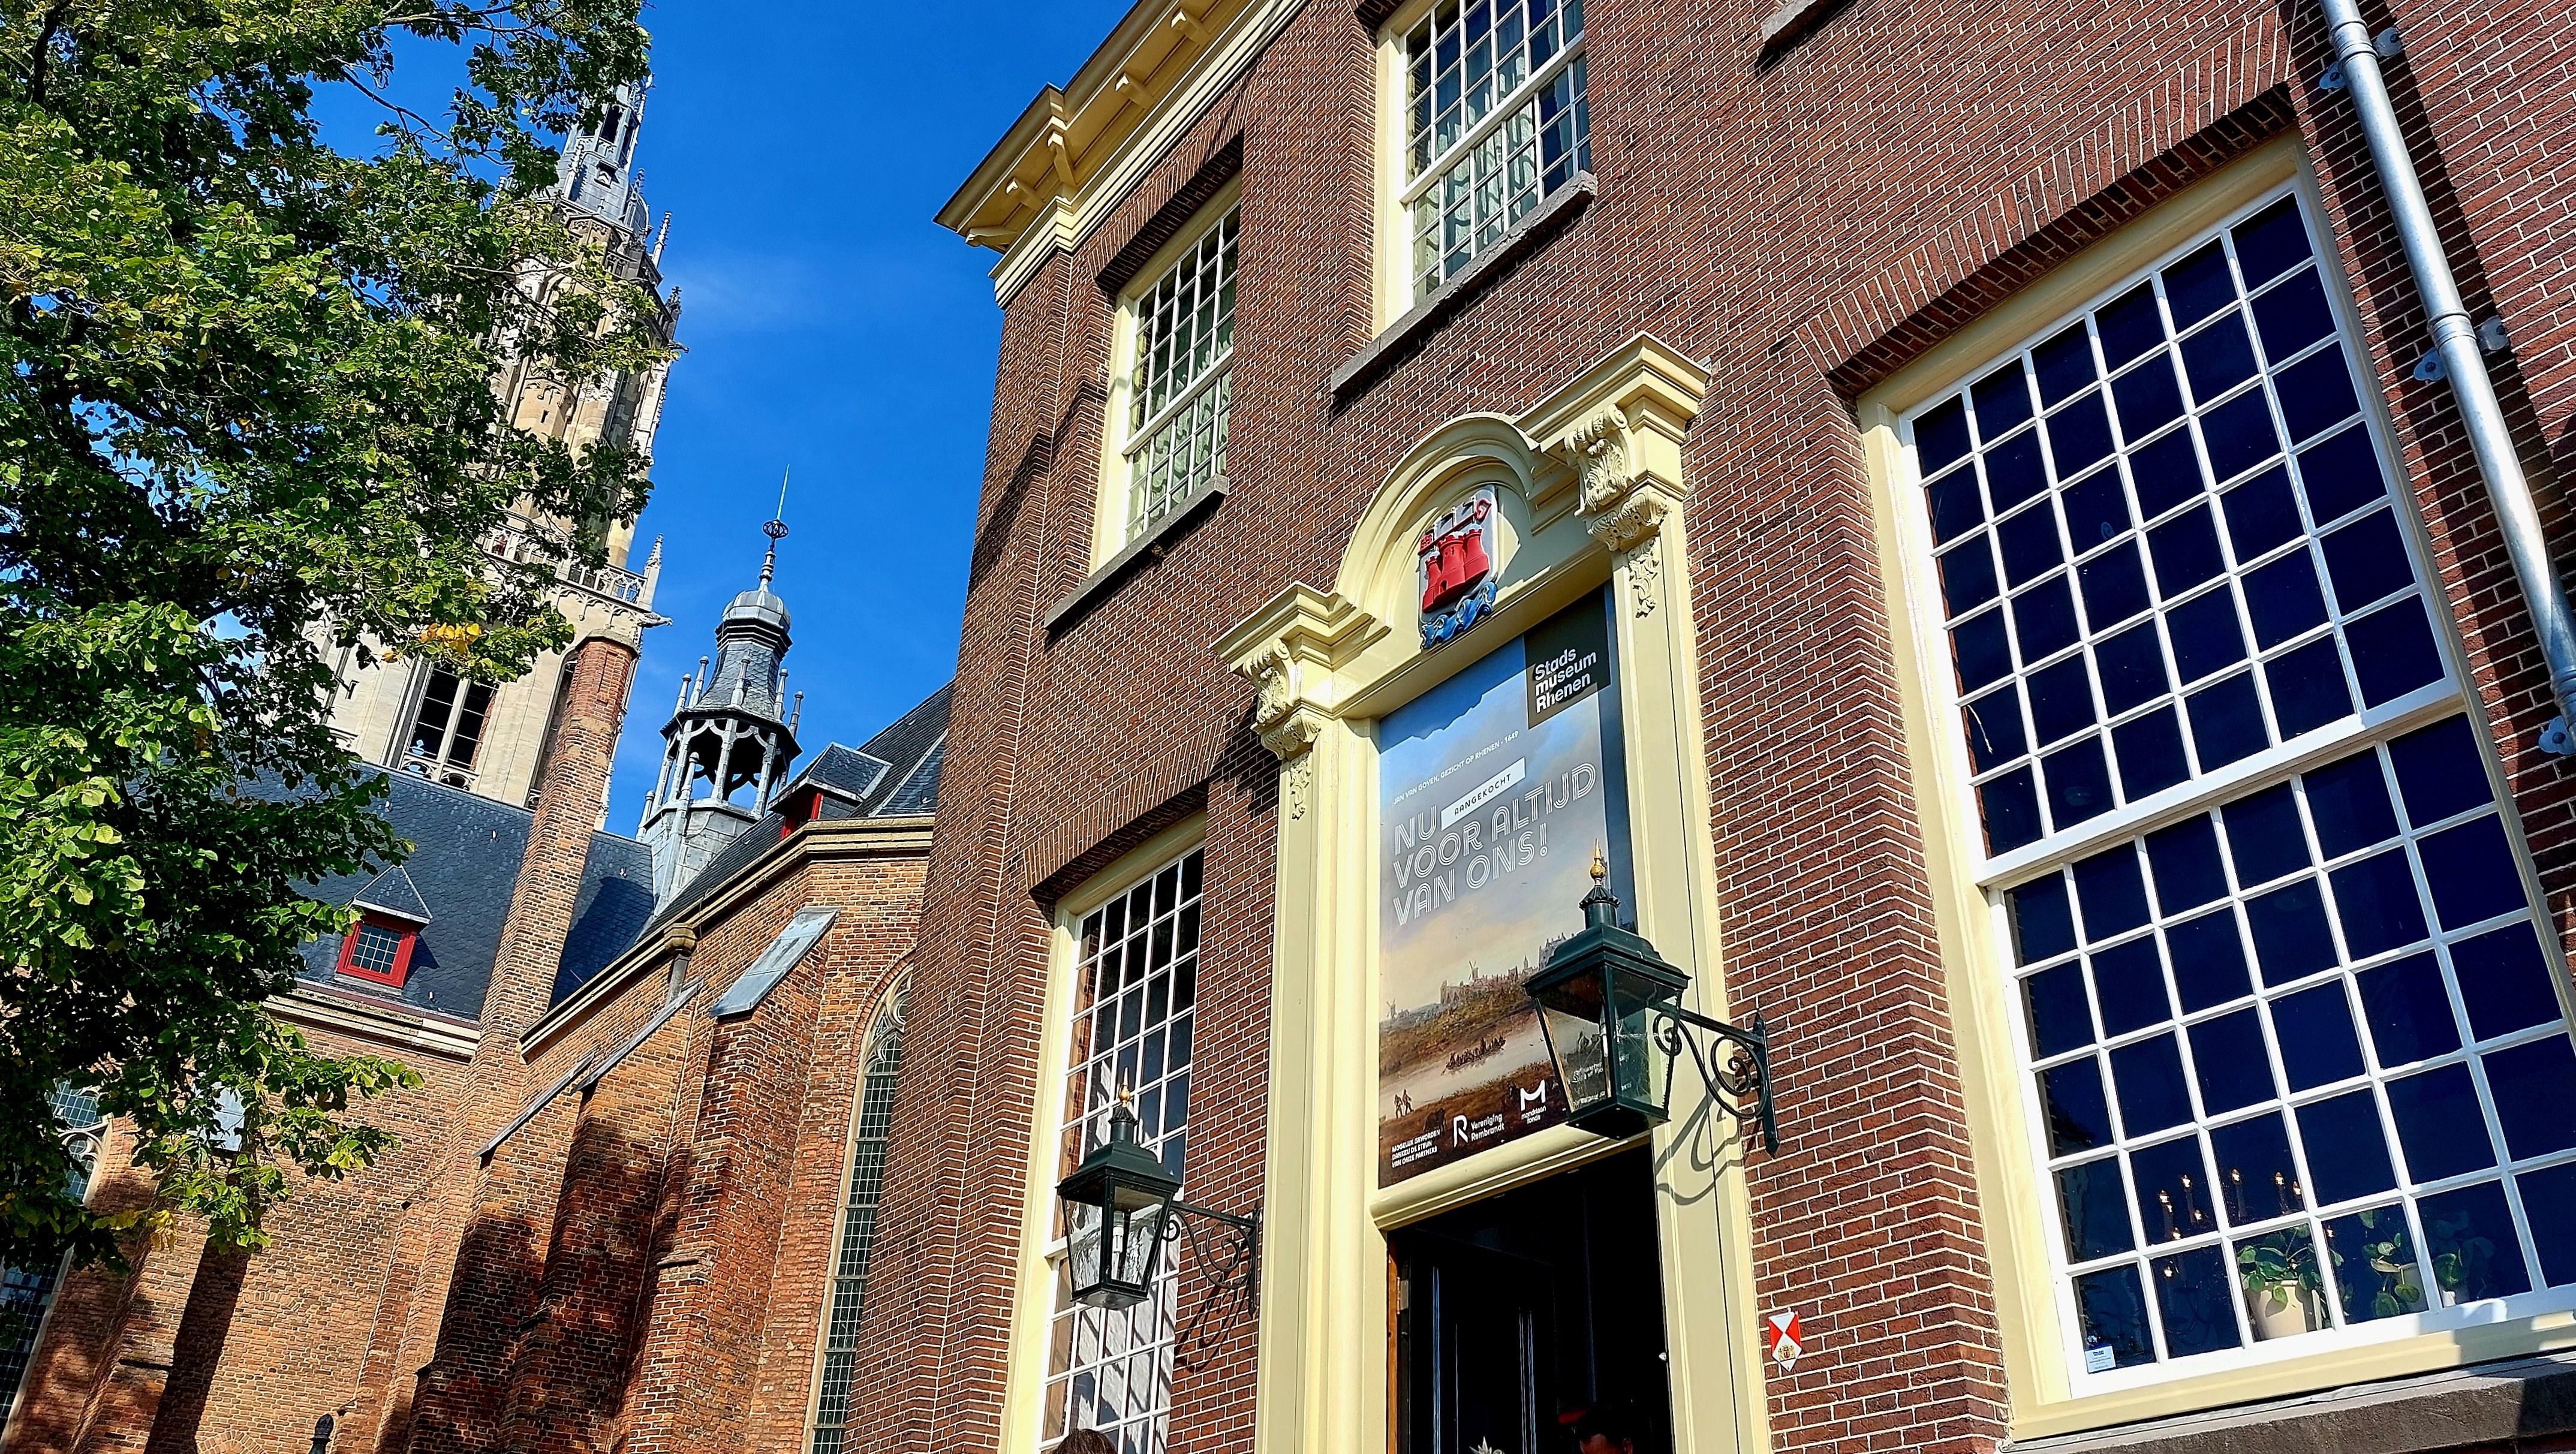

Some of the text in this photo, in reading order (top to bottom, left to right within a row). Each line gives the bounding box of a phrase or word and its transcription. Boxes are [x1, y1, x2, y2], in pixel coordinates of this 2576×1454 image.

[1535, 649, 1576, 681] Stads
[1536, 652, 1597, 697] museum
[1536, 673, 1591, 714] Rhenen
[1394, 793, 1404, 805] JAN
[1405, 786, 1418, 799] VAN
[1418, 775, 1440, 791] GOYEN,
[1440, 760, 1465, 778] GEZICHT
[1465, 755, 1474, 764] OP
[1475, 740, 1500, 760] RHENEN
[1504, 730, 1519, 743] 1649
[1453, 773, 1511, 816] AANGEKOCHT
[1393, 763, 1596, 889] VOOR ALTIJD
[1395, 805, 1437, 856] NU
[1393, 822, 1548, 926] VAN ONS!
[1453, 1115, 1468, 1148] R
[1471, 1113, 1503, 1131] Vereniging
[1471, 1122, 1504, 1142] Rembrandt
